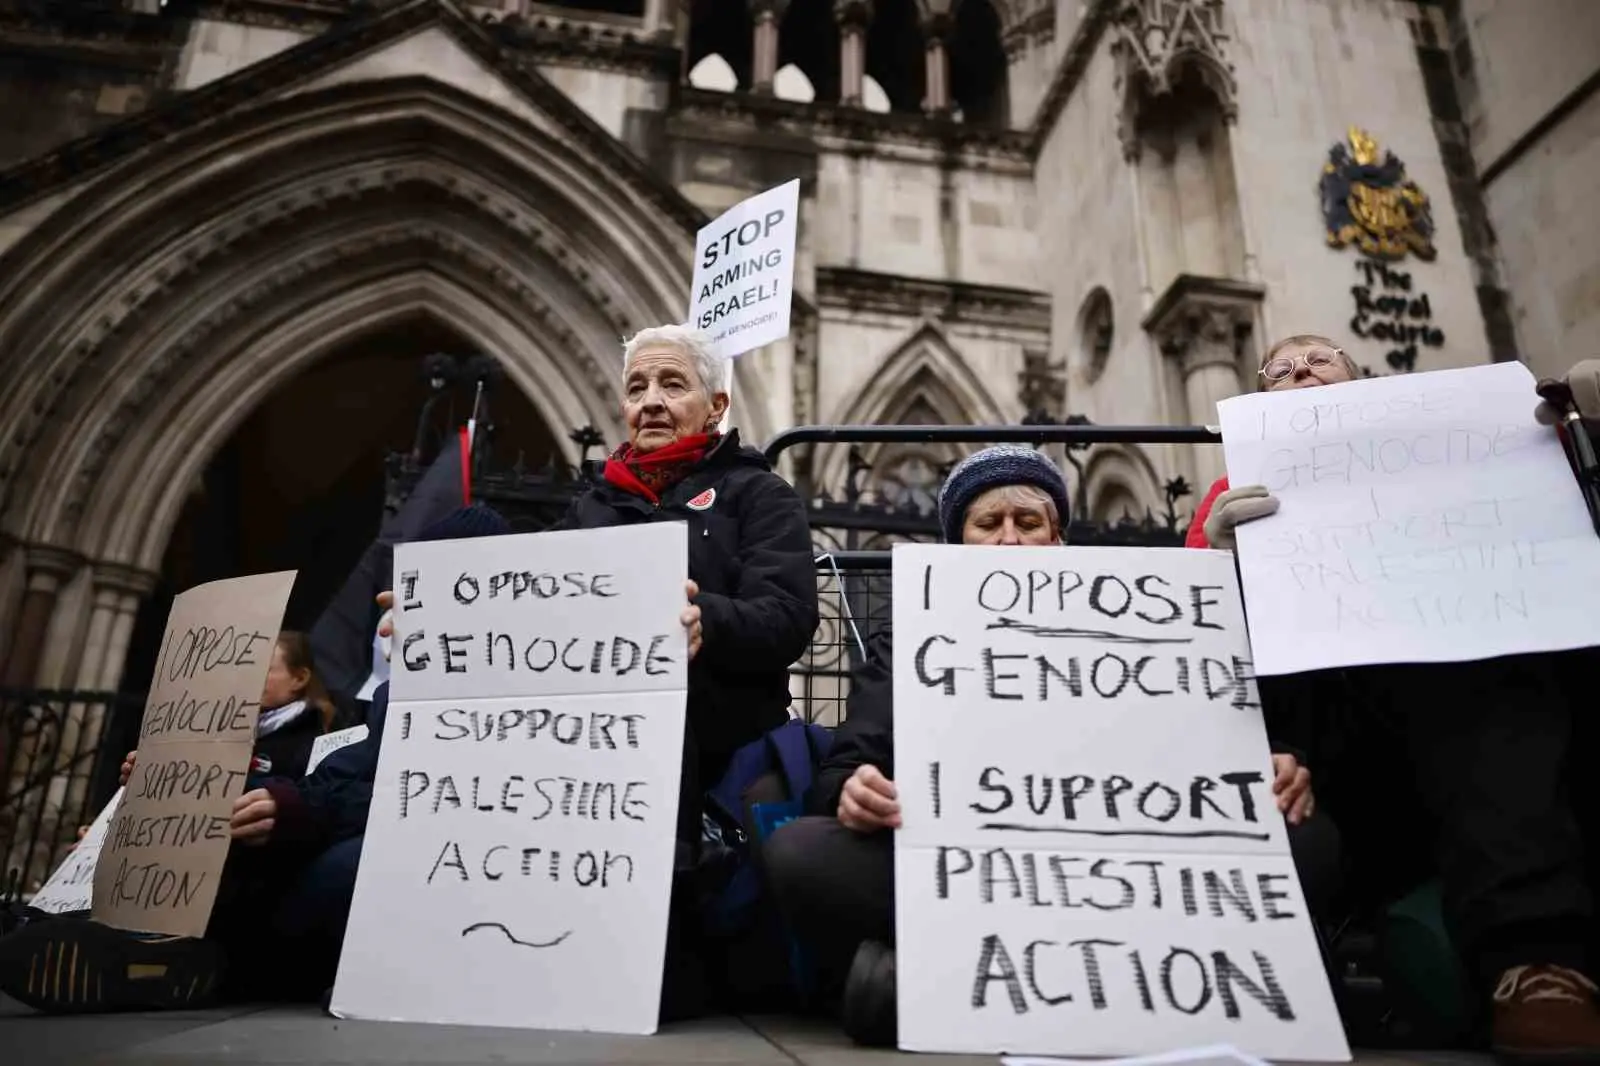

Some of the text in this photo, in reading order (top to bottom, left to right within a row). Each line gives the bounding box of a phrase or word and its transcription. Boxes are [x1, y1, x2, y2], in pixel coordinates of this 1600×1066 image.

[702, 209, 785, 269] STOP
[699, 249, 782, 303] ARMING
[1355, 260, 1411, 290] The
[697, 279, 779, 329] ISRAEL!
[1351, 286, 1431, 320] Royal
[1351, 313, 1445, 347] Courts
[1386, 345, 1418, 371] of
[1289, 393, 1453, 436] OPPOSE
[1263, 424, 1529, 491] GENOCIDE
[400, 570, 620, 611] I OPPOSE
[923, 565, 1225, 630] I OPPOSE
[157, 626, 270, 689] I OPPOSE
[402, 631, 676, 676] GENOCIDE
[914, 634, 1262, 710] GENOCIDE
[142, 690, 261, 738] GENOCIDE
[401, 709, 646, 750] I SUPPORT
[137, 761, 246, 800] SUPPORT
[399, 770, 650, 822] PALESTINE
[930, 761, 1264, 822] I SUPPORT
[112, 814, 231, 854] PALESTINE
[110, 858, 206, 909] ACTION
[936, 846, 1296, 922] PALESTINE
[971, 934, 1297, 1021] ACTION
